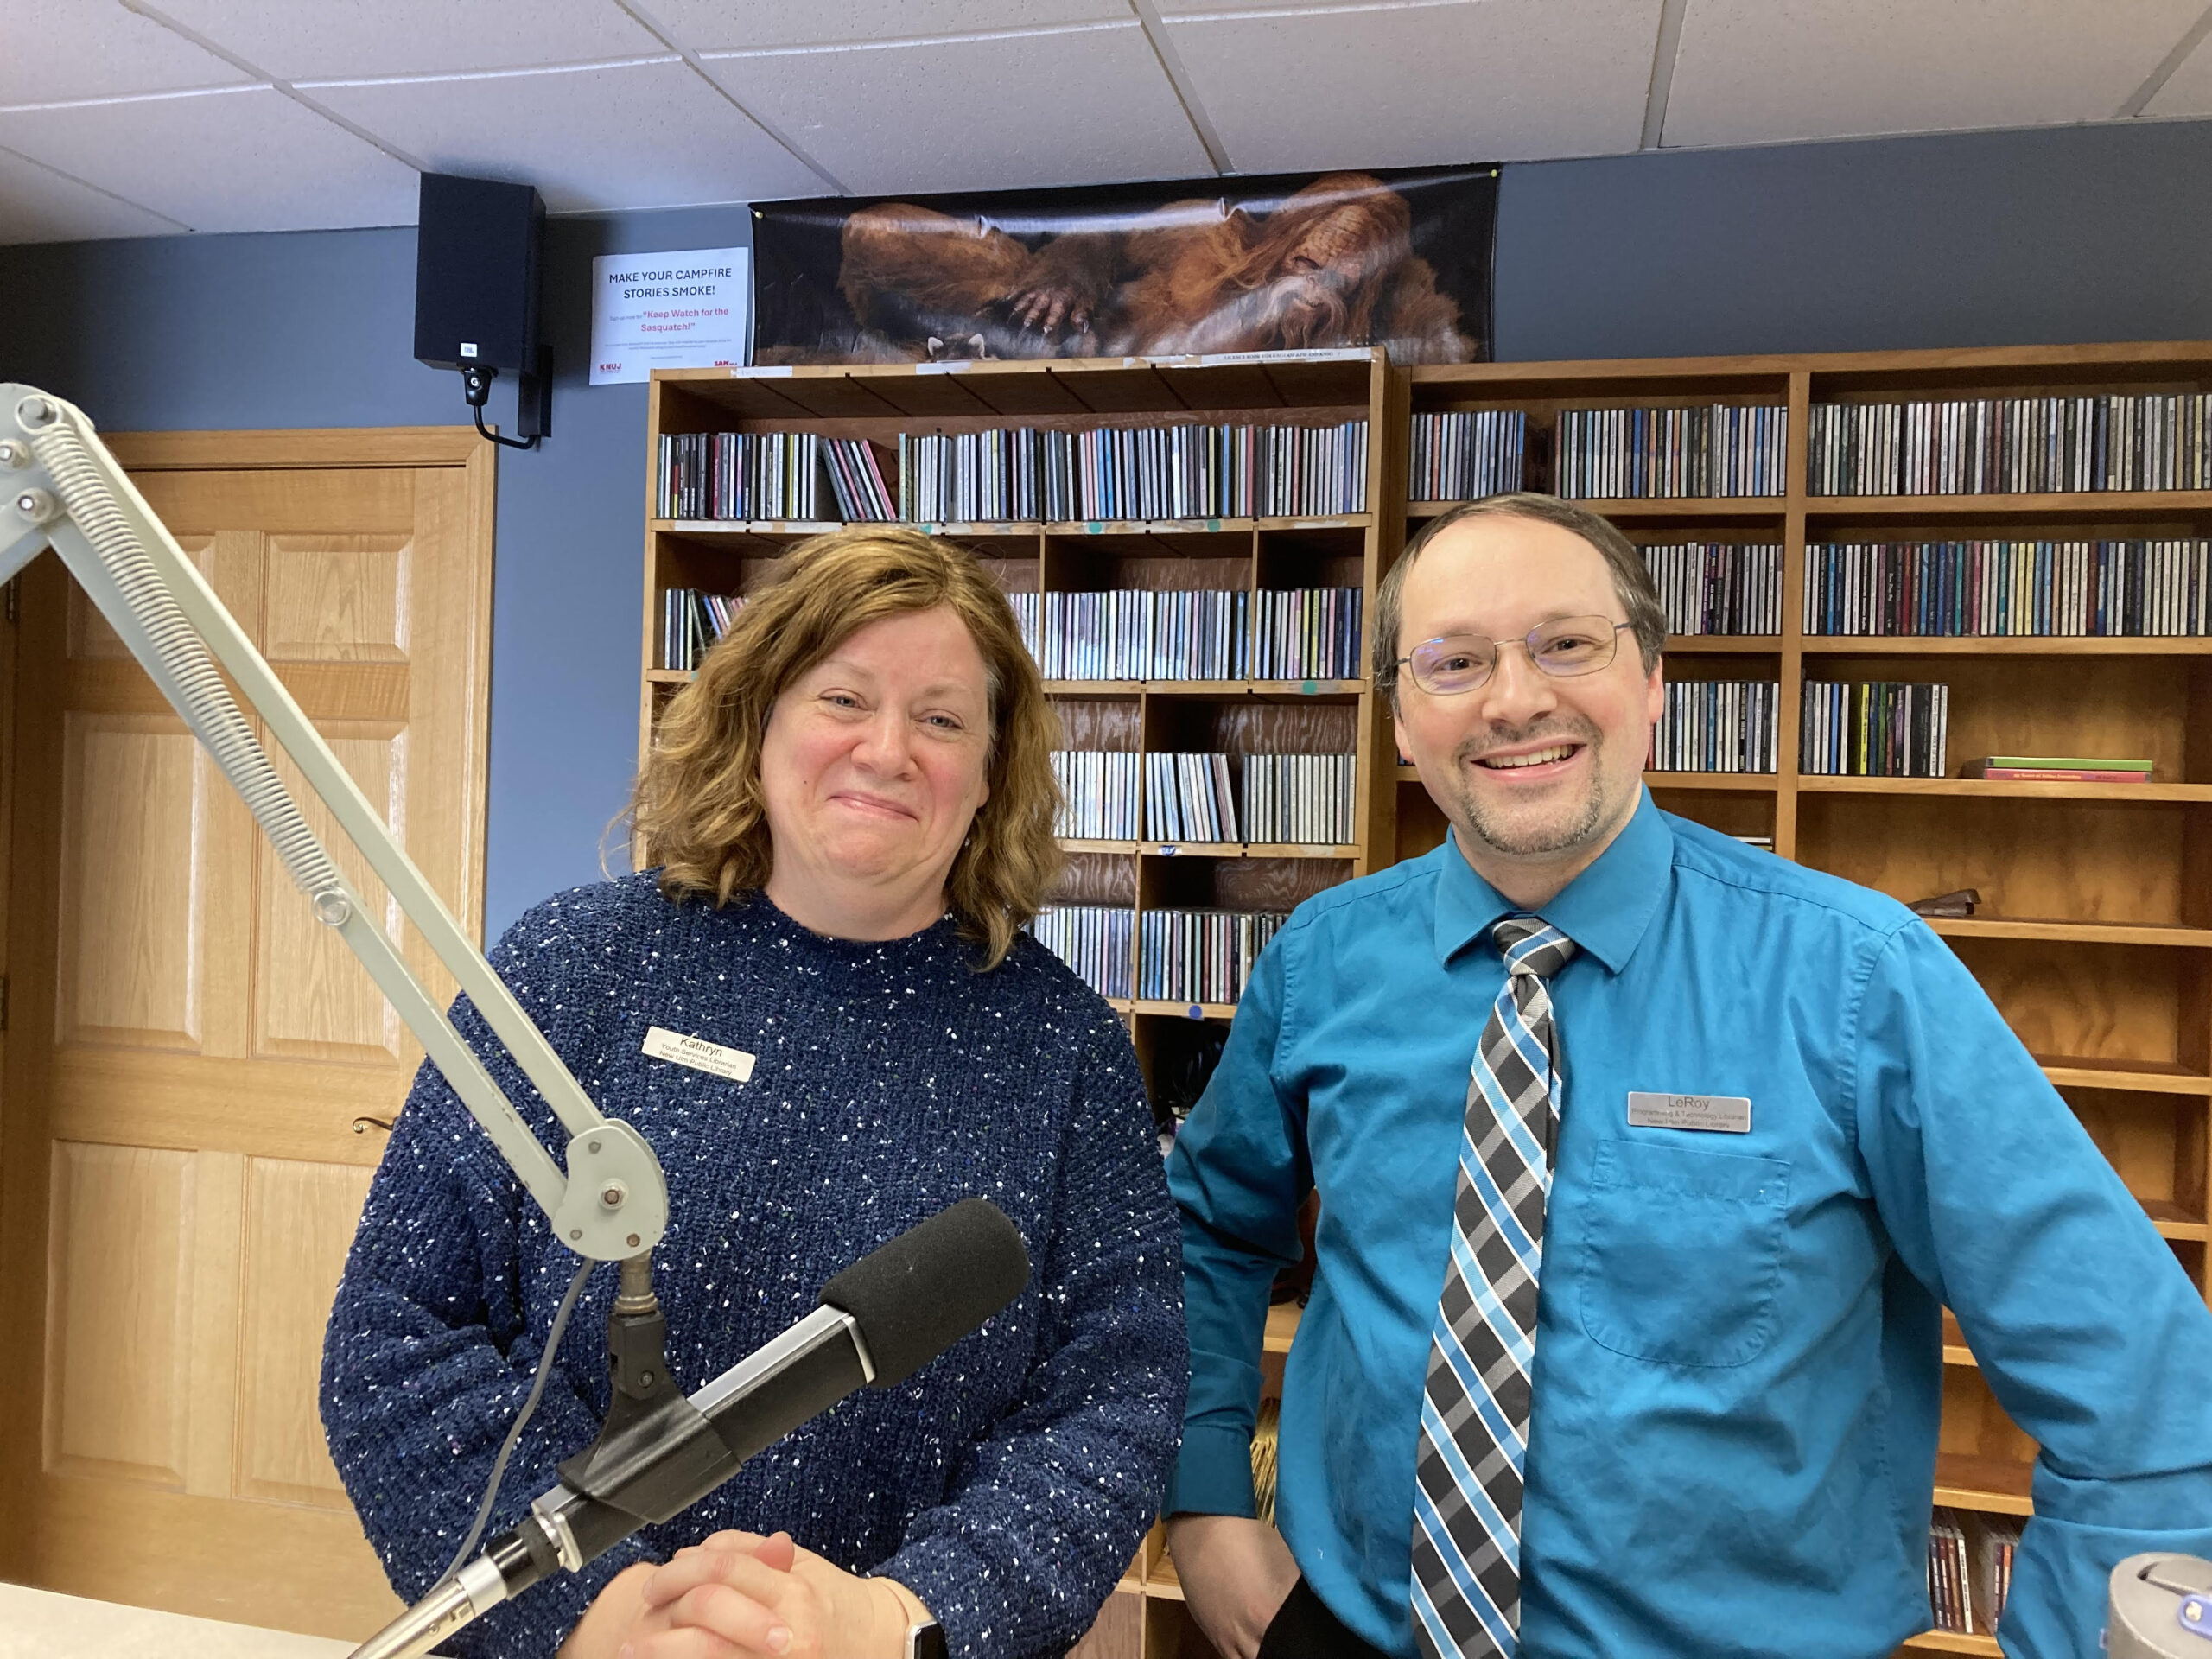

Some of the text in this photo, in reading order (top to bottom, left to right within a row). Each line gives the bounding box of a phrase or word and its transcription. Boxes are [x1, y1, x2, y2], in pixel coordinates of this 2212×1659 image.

[609, 268, 732, 283] MAKE YOUR CAMPFIRE
[623, 285, 715, 299] STORIES SMOKE!
[671, 308, 699, 317] Watch
[680, 1036, 723, 1057] Kathryn
[659, 1050, 733, 1077] New Ulm Public Library
[661, 1043, 737, 1070] Youth Services Librarian
[1668, 1096, 1710, 1111] LeRoy
